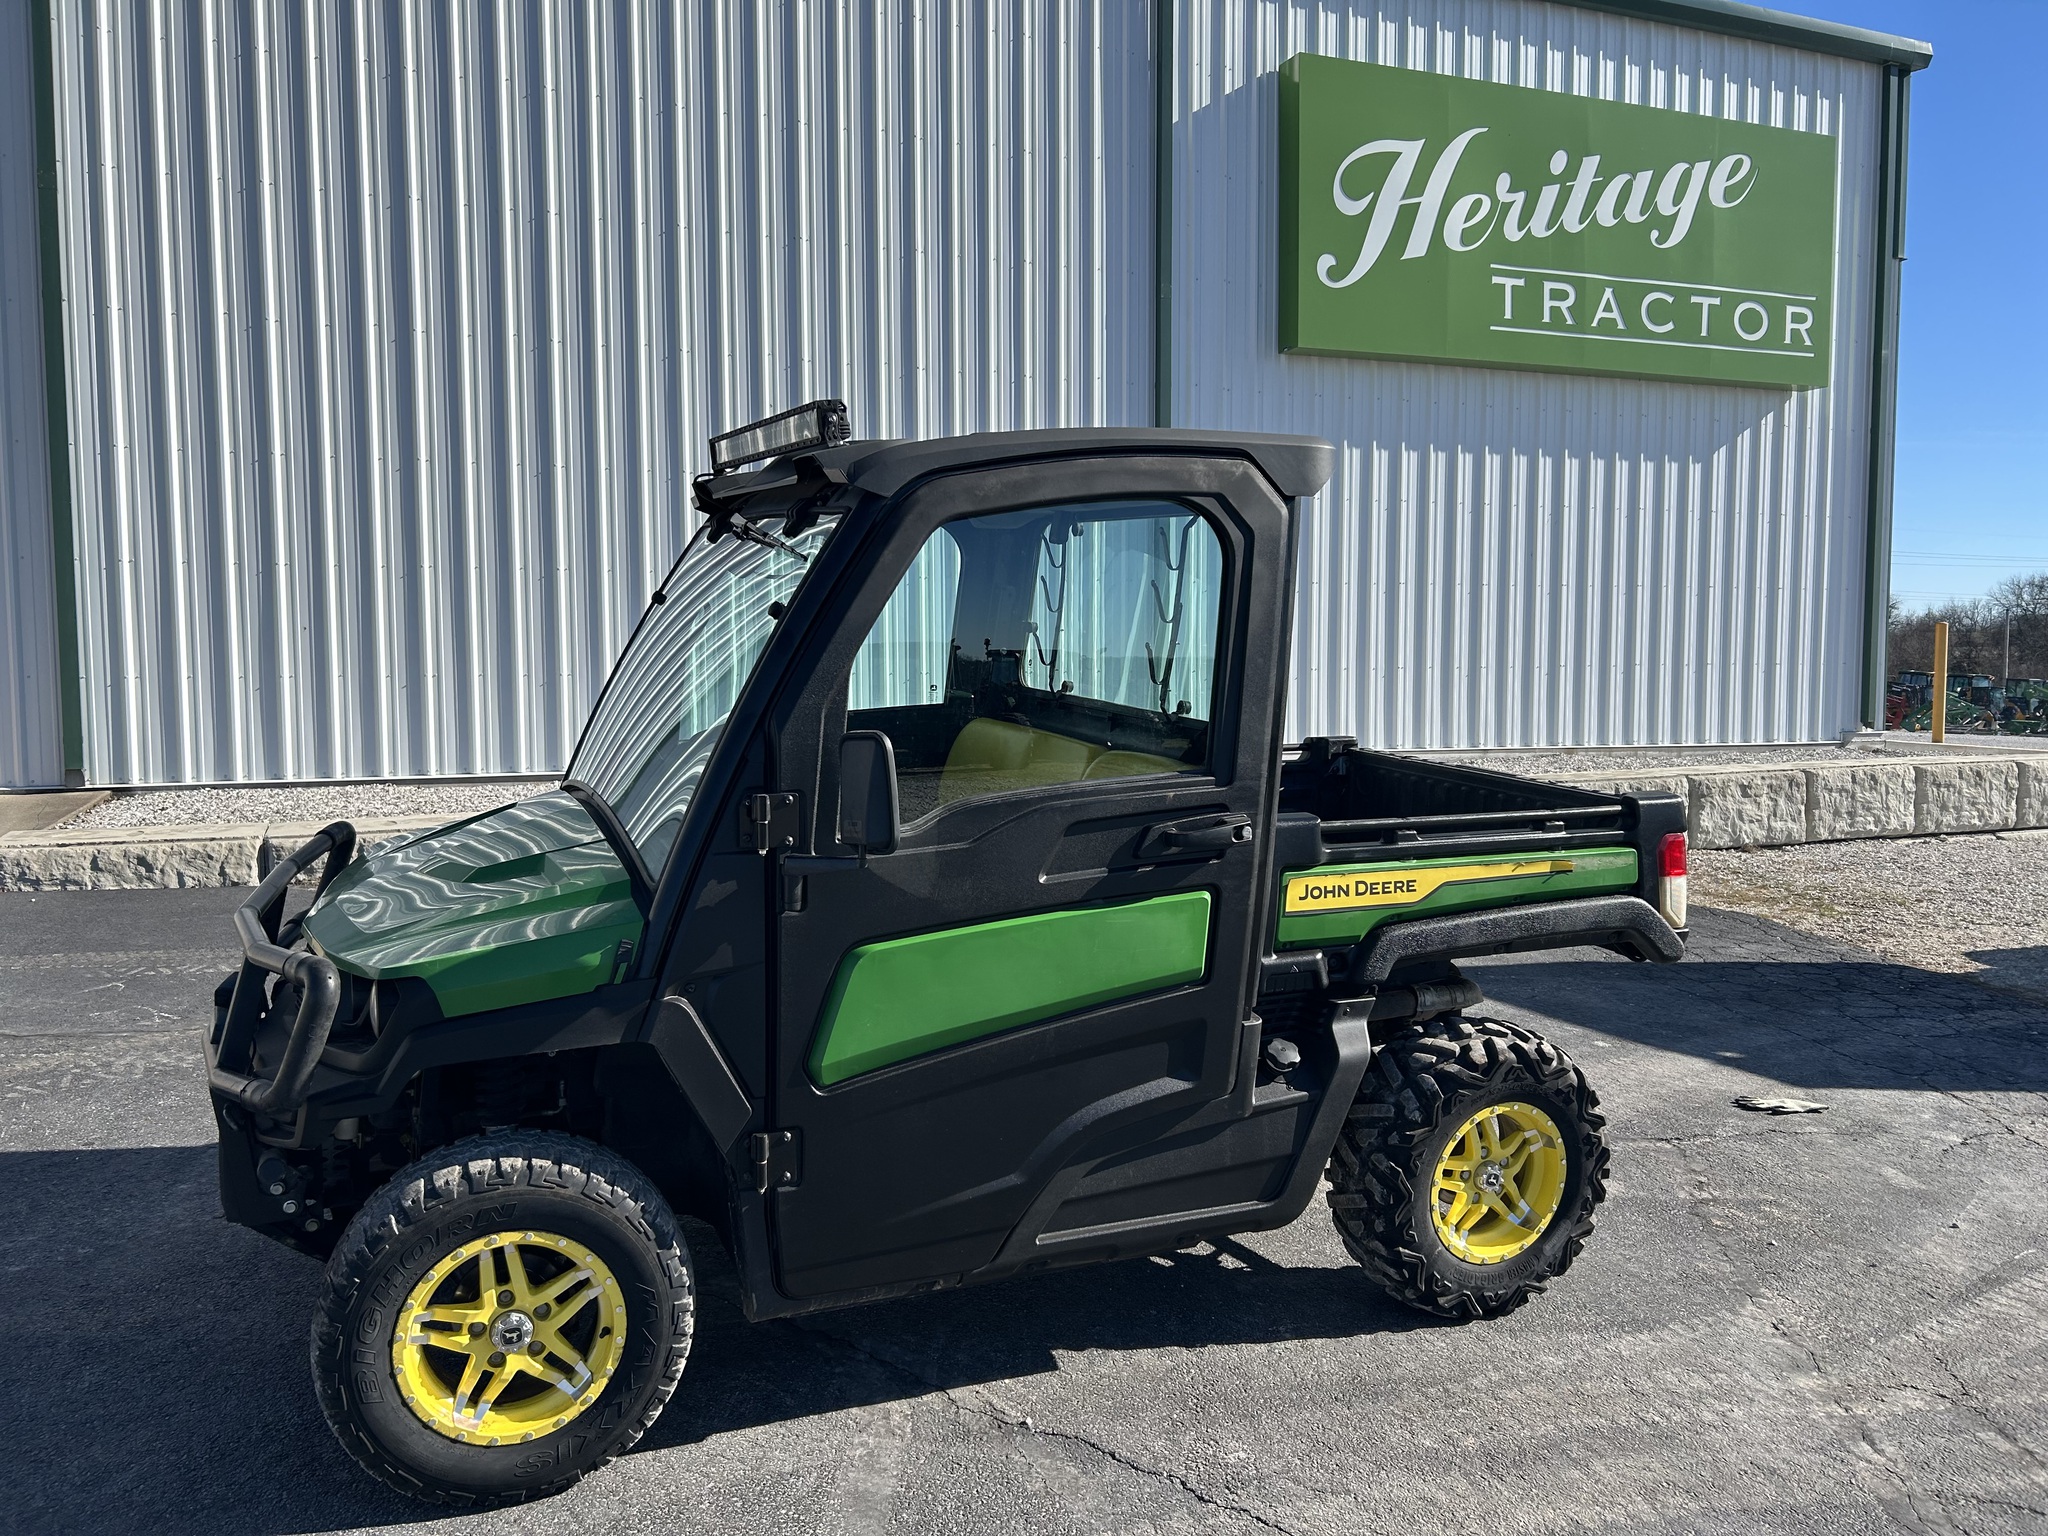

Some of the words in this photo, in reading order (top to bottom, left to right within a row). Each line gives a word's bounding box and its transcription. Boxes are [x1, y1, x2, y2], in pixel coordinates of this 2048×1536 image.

[1316, 127, 1759, 289] Heritage
[1491, 275, 1815, 346] TRACTOR
[1298, 884, 1350, 901] JOHN
[1355, 879, 1417, 897] DEERE
[355, 1201, 518, 1404] BIGHORN
